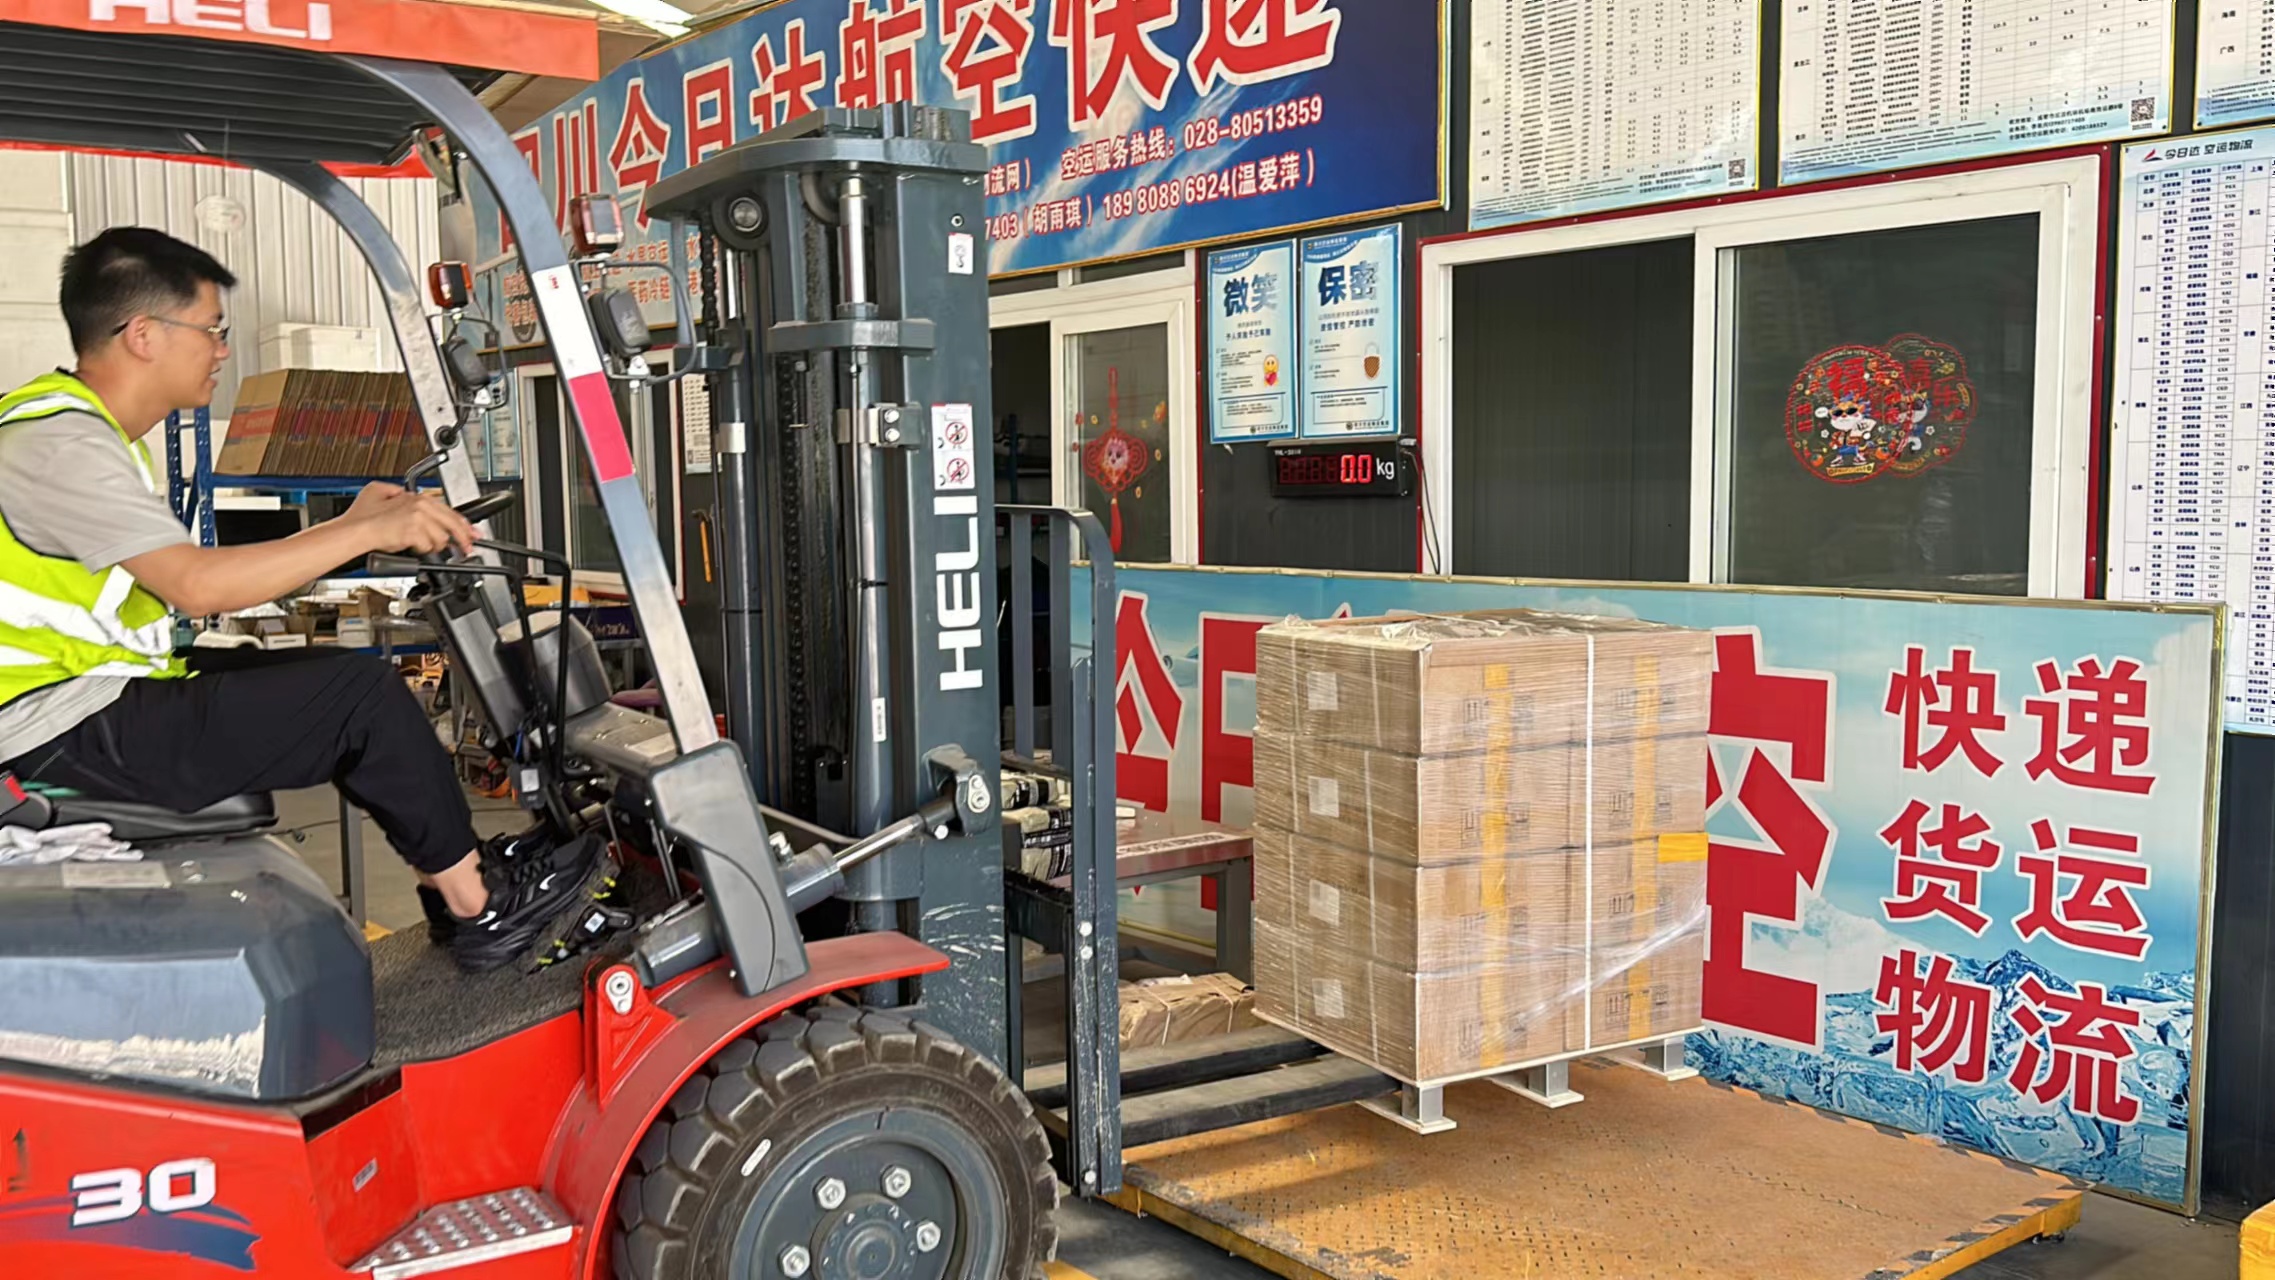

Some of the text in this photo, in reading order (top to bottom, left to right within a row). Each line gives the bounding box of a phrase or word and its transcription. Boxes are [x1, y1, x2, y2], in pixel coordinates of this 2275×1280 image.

[2203, 138, 2254, 155] 空运物流
[1137, 181, 1181, 215] 8088
[1223, 271, 1281, 318] 微笑
[1317, 260, 1380, 308] 保密
[1340, 454, 1395, 484] 0.0 kg
[933, 495, 983, 691] HELI
[1884, 643, 2156, 796] 快递
[1877, 799, 2152, 961] 货运
[1873, 949, 2143, 1126] 物流
[70, 1156, 217, 1229] 30
